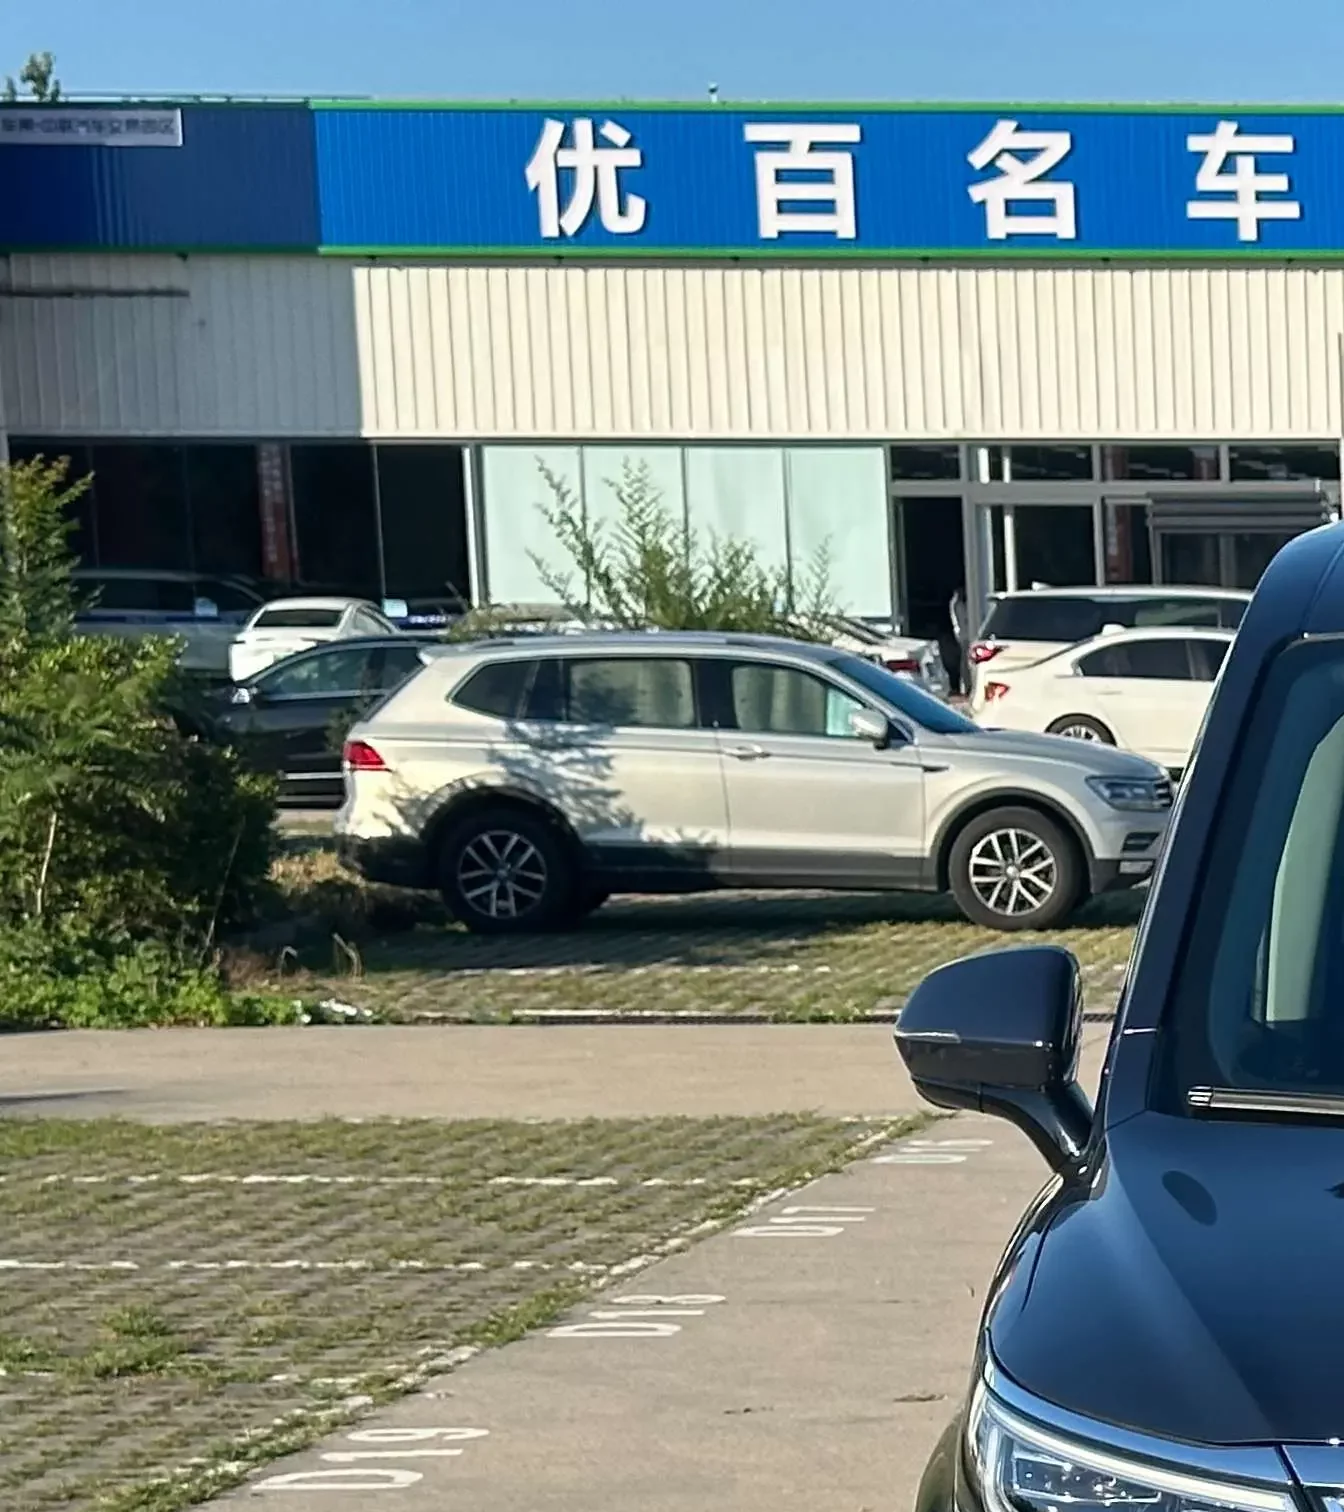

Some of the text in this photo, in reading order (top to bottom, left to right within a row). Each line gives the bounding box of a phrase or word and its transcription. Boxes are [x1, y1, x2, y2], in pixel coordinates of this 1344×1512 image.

[524, 117, 1303, 242] 优百名车
[250, 1426, 490, 1490] D19
